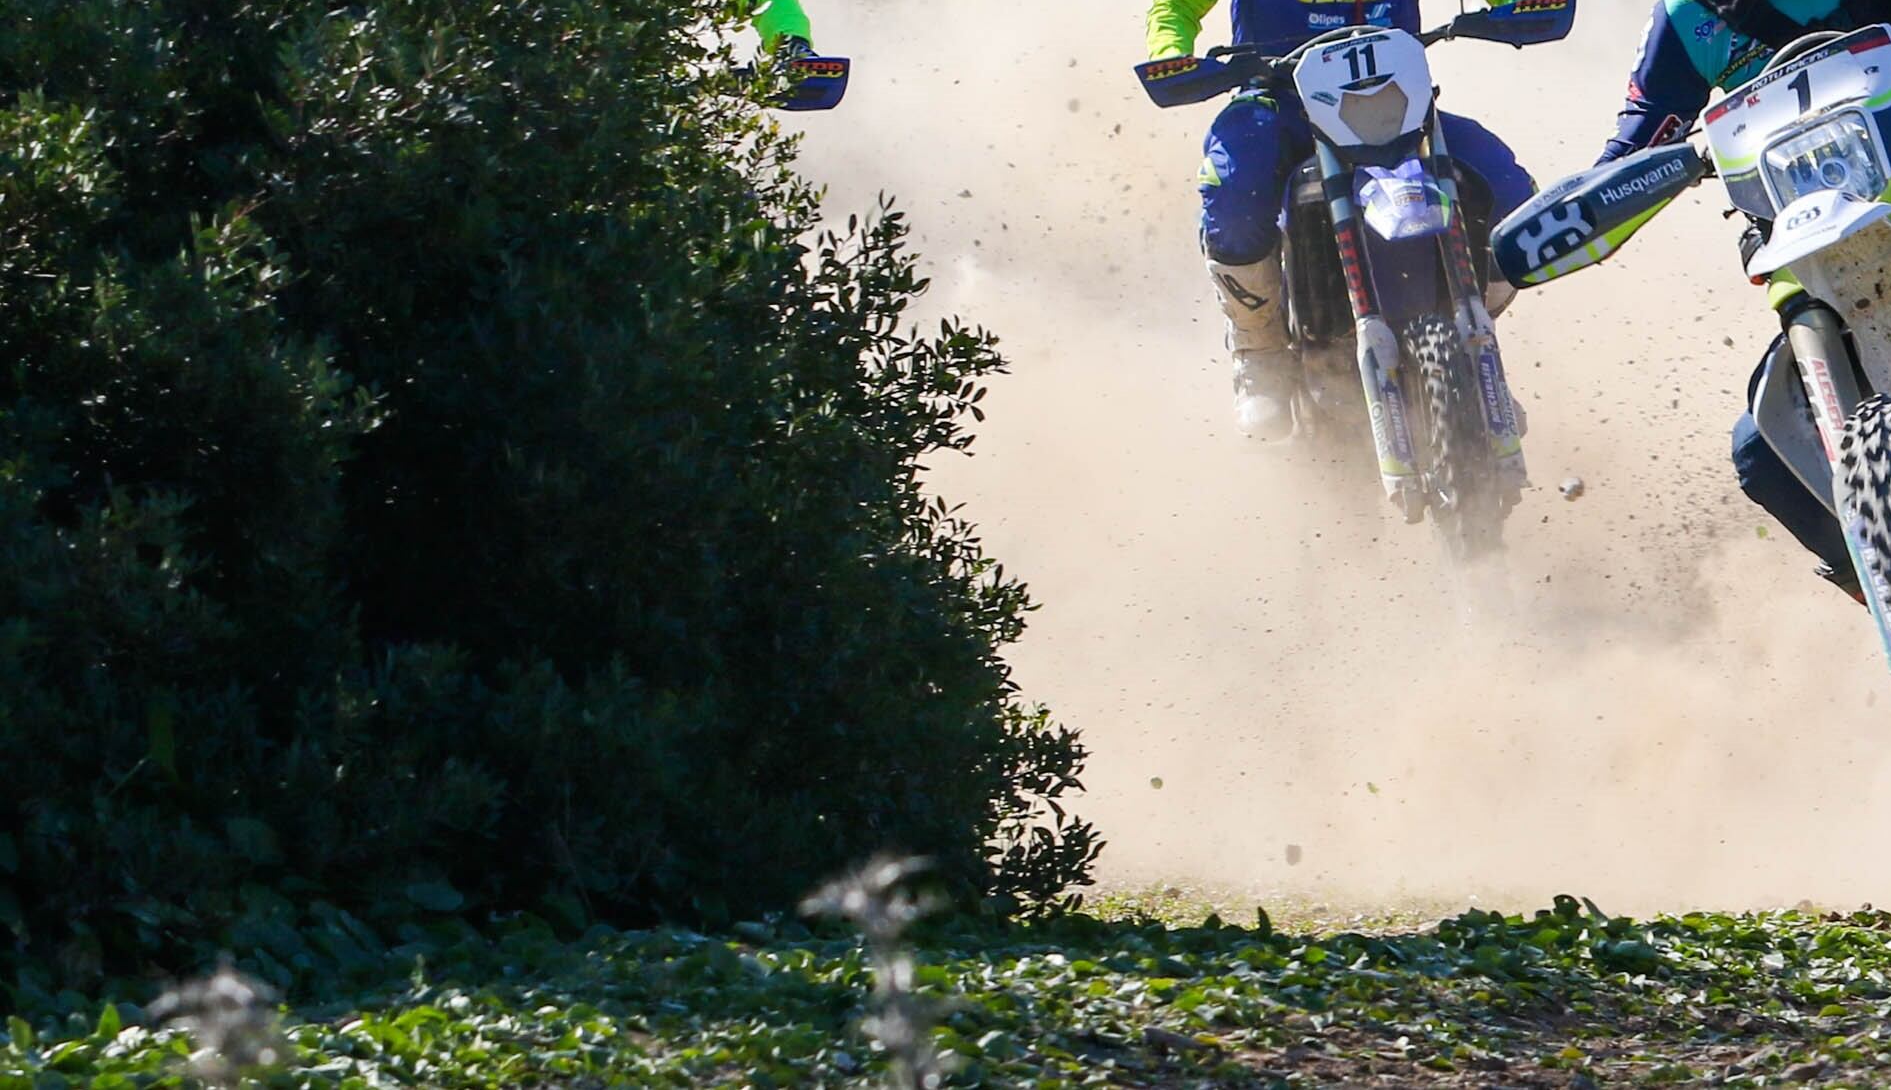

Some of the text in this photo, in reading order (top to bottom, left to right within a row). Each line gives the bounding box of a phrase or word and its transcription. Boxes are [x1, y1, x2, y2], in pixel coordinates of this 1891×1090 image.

[1342, 43, 1377, 81] 11
[1787, 68, 1812, 112] 1
[1600, 157, 1685, 206] Husqvarna
